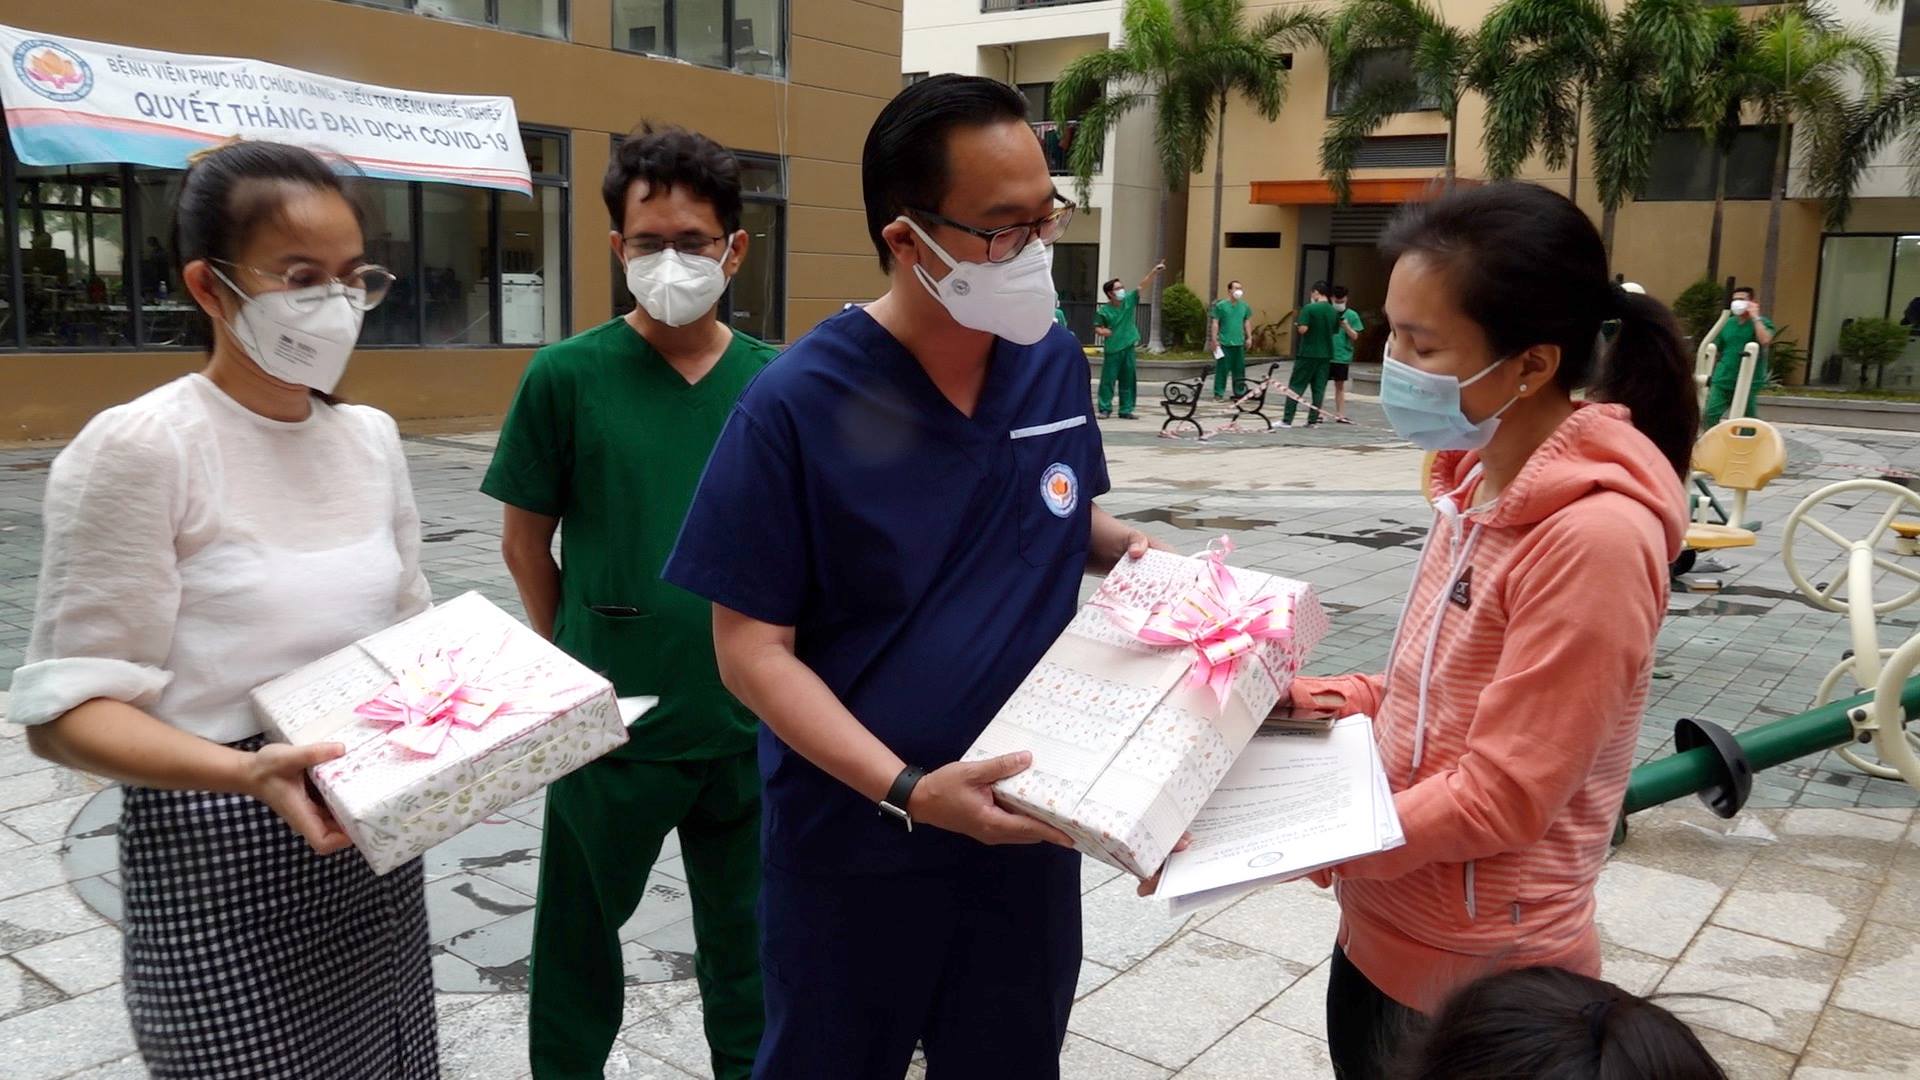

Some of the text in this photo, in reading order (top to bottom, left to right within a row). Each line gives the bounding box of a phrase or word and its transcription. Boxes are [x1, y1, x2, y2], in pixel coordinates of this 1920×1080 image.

[134, 90, 222, 124] QUYẾT
[320, 112, 363, 137] ĐẠI
[363, 118, 418, 142] DỊCH
[420, 126, 508, 152] COVID-19
